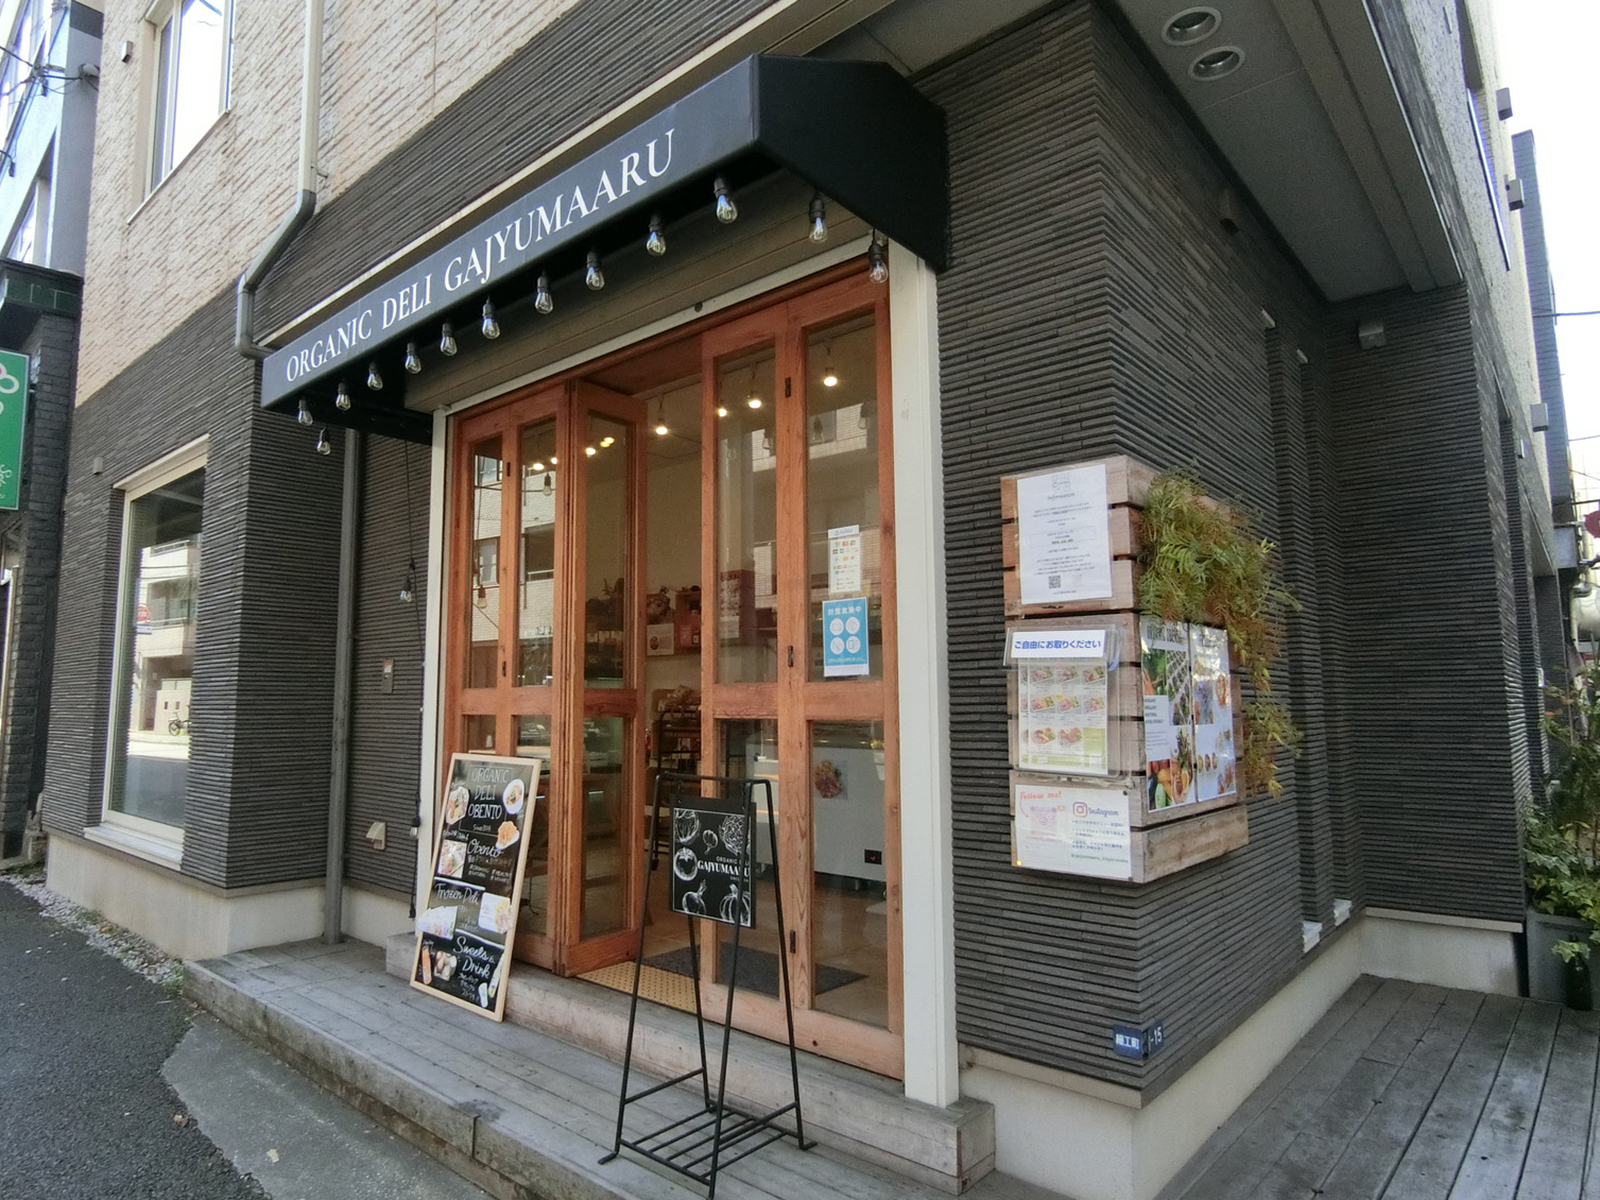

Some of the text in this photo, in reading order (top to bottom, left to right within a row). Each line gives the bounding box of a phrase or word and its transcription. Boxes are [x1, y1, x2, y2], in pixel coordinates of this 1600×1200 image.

[286, 128, 676, 382] ORGANIC DELI GAJYUMAARU
[1014, 639, 1102, 650] ご自由にお取りください
[474, 785, 497, 801] DELI
[468, 803, 503, 820] OBENTO
[467, 838, 504, 858] Obento
[697, 860, 750, 878] GAJYUMAAU
[434, 883, 481, 906] Frozen Deli
[462, 955, 492, 980] Drink
